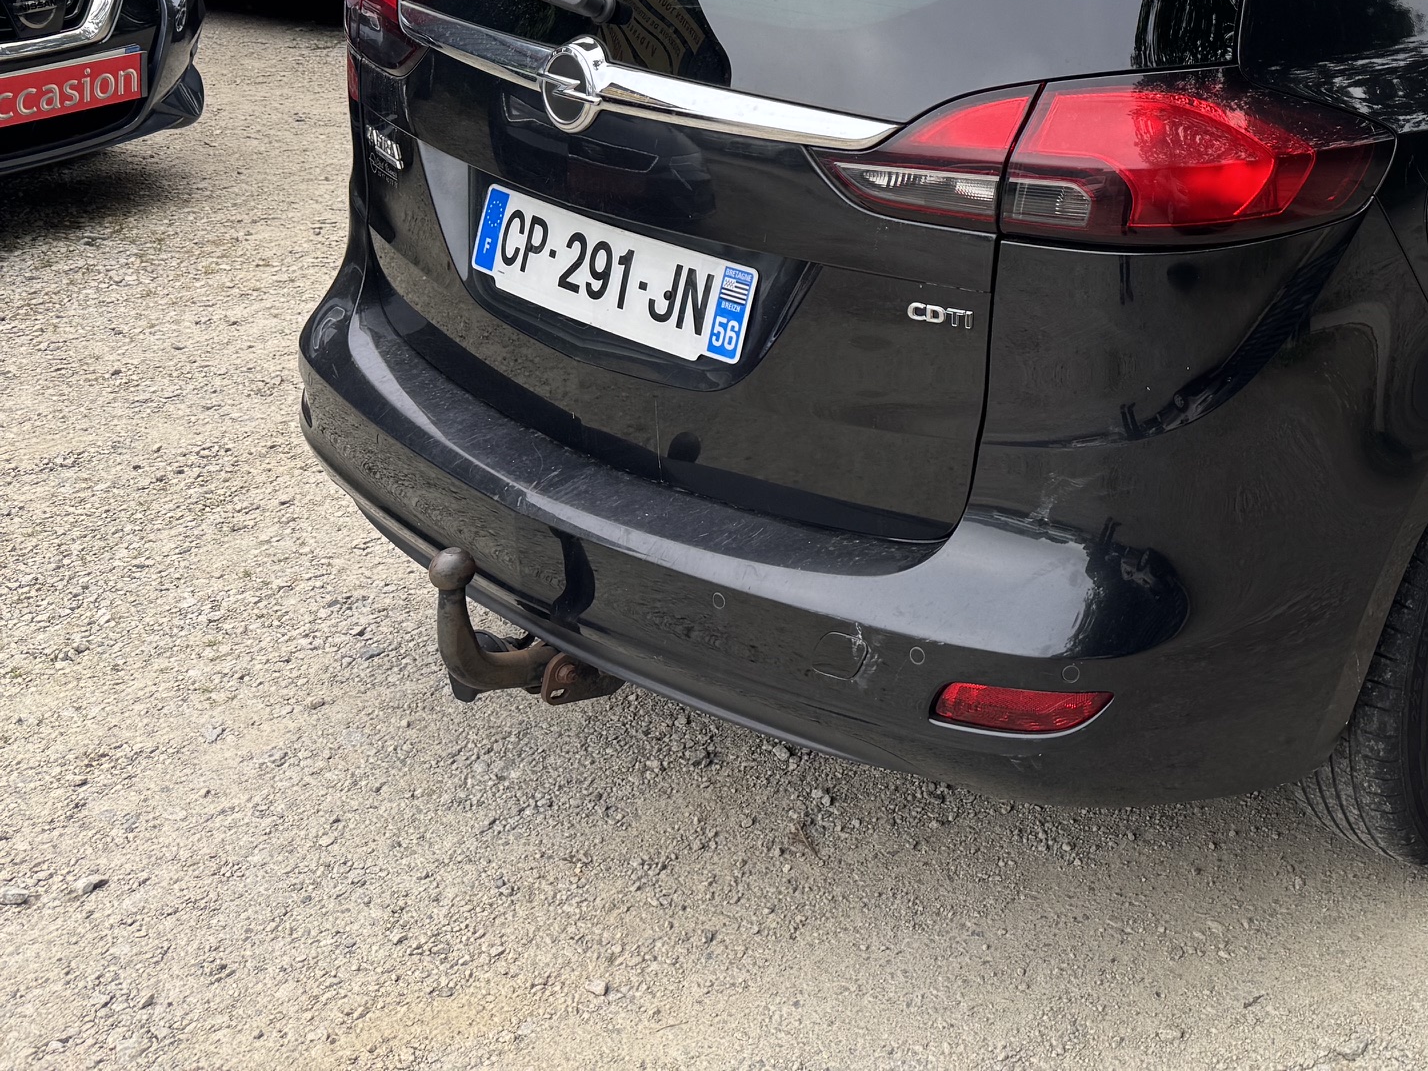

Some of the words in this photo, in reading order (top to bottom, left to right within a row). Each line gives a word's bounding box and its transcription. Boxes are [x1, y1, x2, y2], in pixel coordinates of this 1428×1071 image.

[482, 238, 492, 254] F
[500, 209, 715, 336] CP-291-JN
[725, 268, 753, 282] BRETAGNE
[907, 302, 973, 329] CDTI
[711, 316, 740, 351] 56
